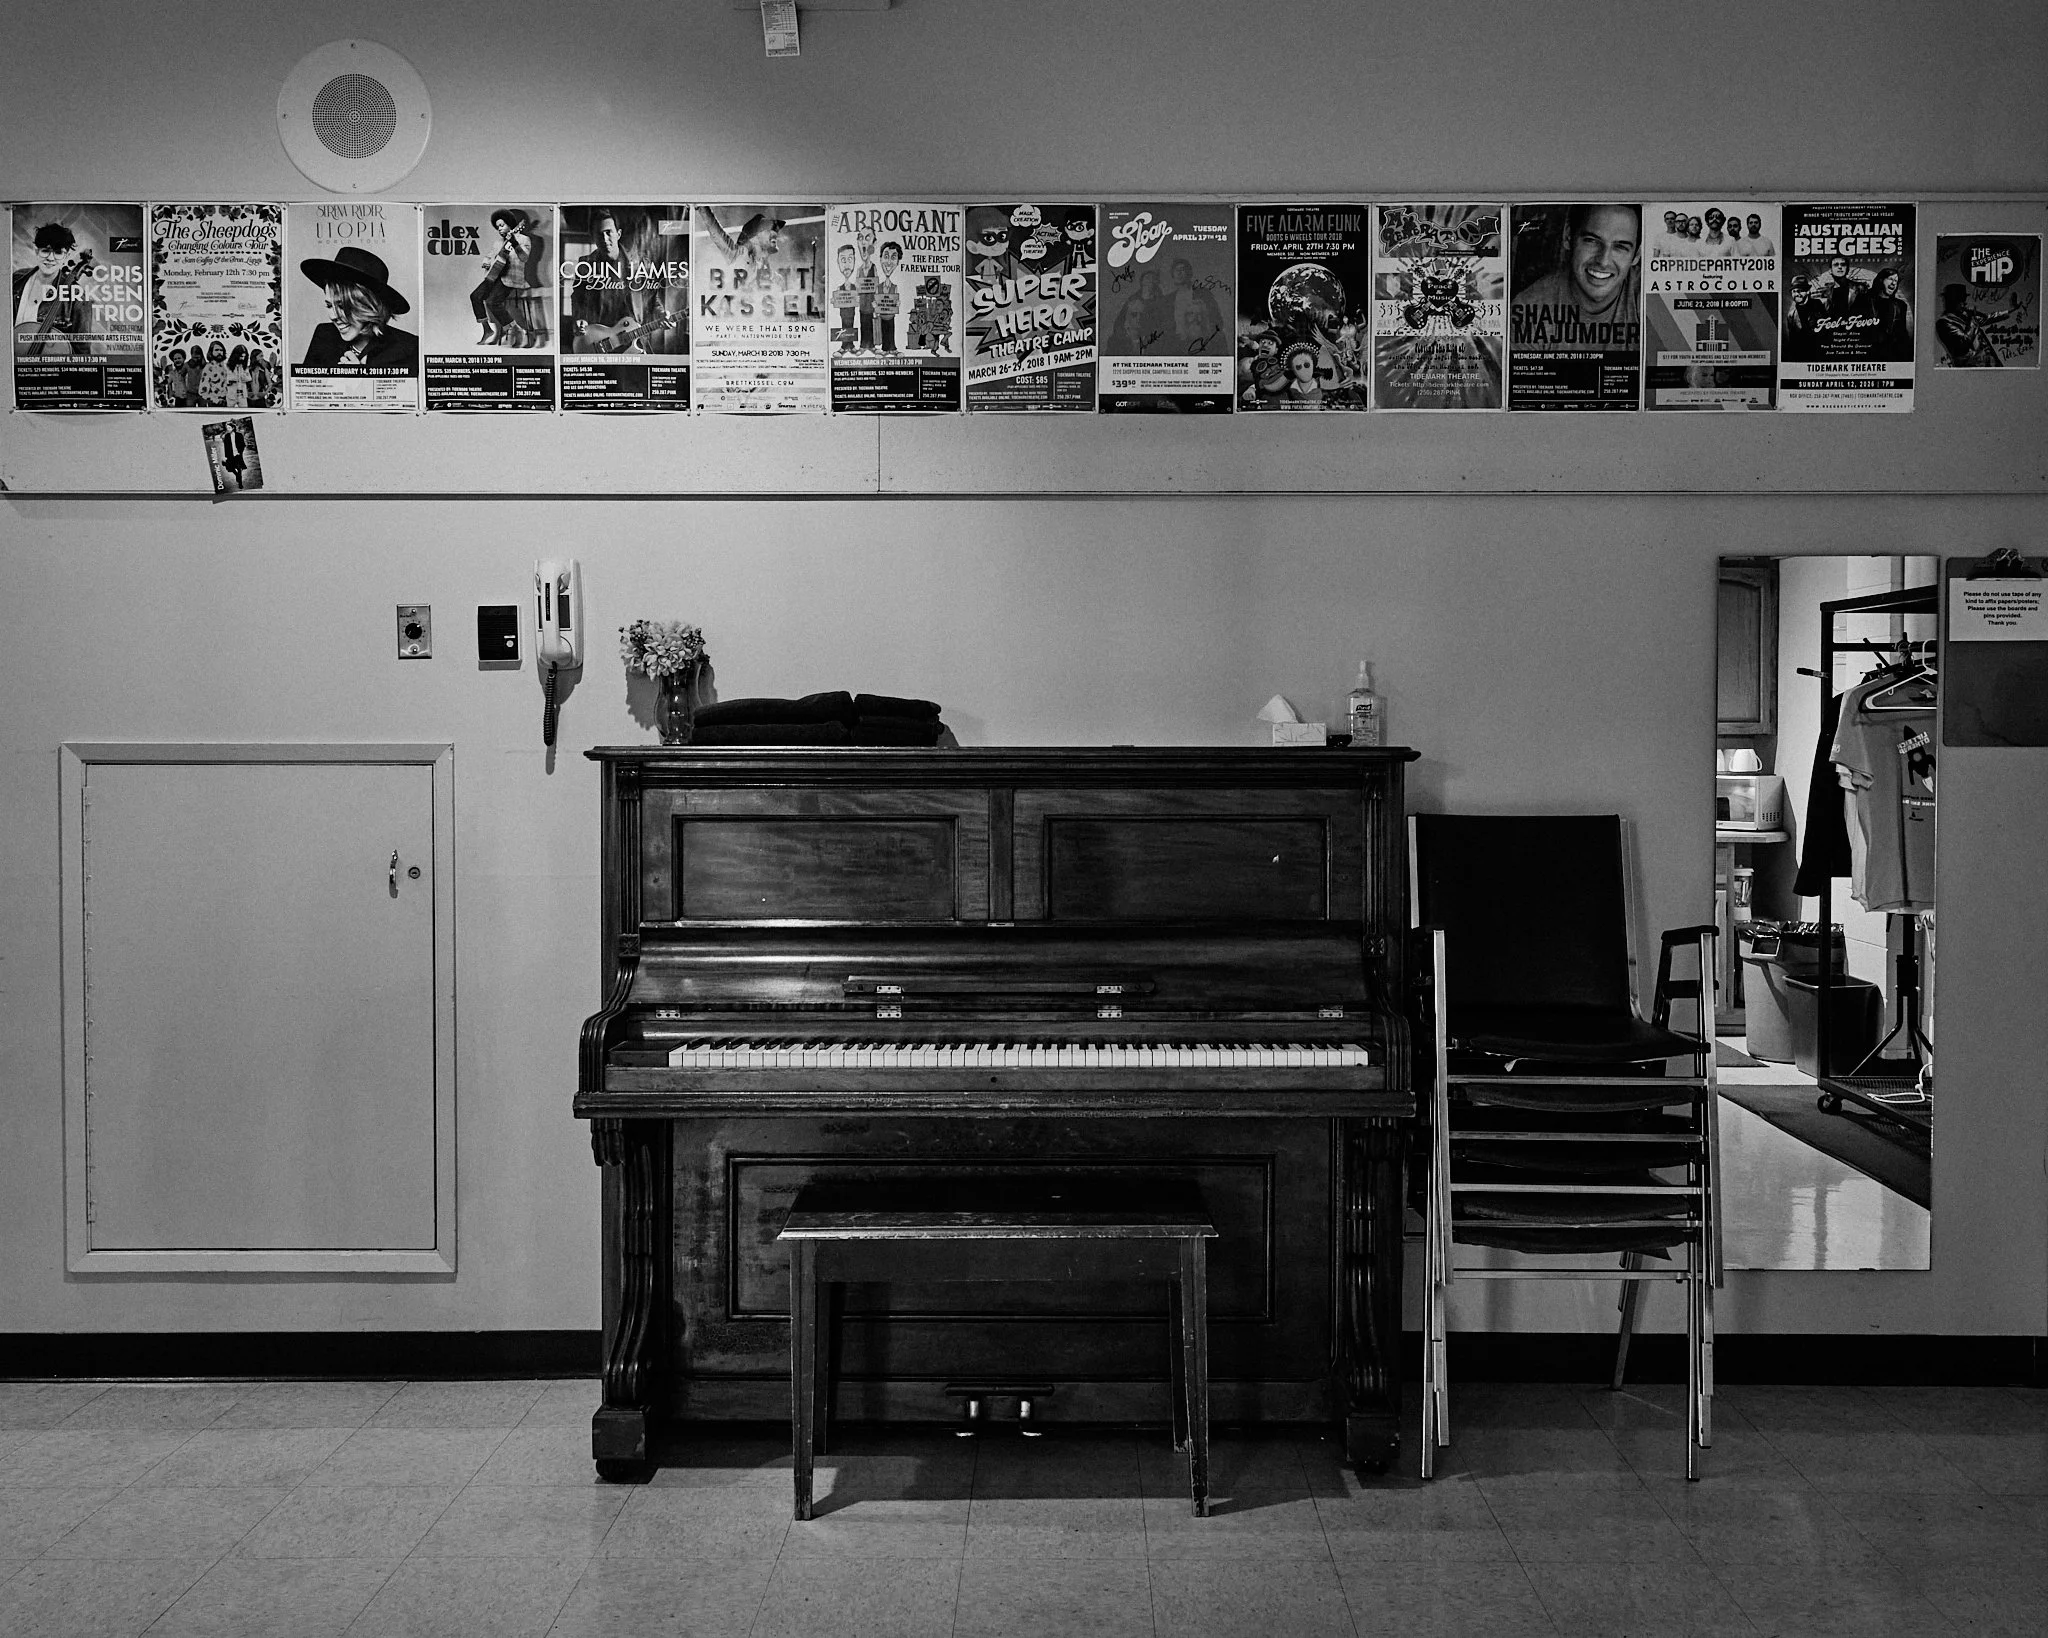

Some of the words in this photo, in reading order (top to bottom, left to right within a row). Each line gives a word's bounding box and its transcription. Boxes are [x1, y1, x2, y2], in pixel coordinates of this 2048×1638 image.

[154, 216, 190, 239] The
[192, 219, 277, 243] Sheepdogs
[427, 219, 480, 239] alex
[831, 214, 840, 227] THE
[837, 209, 960, 234] ARROGANT
[1246, 215, 1274, 239] FIVE
[1279, 214, 1324, 232] ALARM
[1328, 214, 1360, 232] FUNK
[1799, 223, 1903, 236] AUSTRALIAN
[316, 221, 386, 239] UTOPIA
[1289, 233, 1313, 241] WHEELS
[1314, 233, 1327, 241] TOUR
[168, 240, 209, 254] Changing
[211, 240, 243, 251] Colours
[244, 240, 269, 250] Tour
[427, 239, 481, 256] CUBA
[902, 235, 961, 252] WORMS
[1107, 212, 1173, 267] Sloan
[1251, 243, 1280, 251] FRIDAY,
[1283, 243, 1304, 251] APRIL
[1306, 243, 1324, 251] 27TH
[1326, 243, 1340, 251] 7:30
[1342, 243, 1355, 251] PM
[912, 254, 928, 263] THE
[928, 254, 949, 263] FIRST
[1971, 248, 1991, 260] THE
[1971, 249, 2011, 267] EXPERIENCE
[92, 264, 143, 283] CRIS
[163, 269, 193, 277] Monday,
[194, 269, 224, 277] February
[560, 261, 621, 279] COLIN
[626, 261, 689, 281] JAMES
[900, 264, 940, 273] FAREWELL
[941, 264, 961, 273] TOUR
[1650, 259, 1775, 272] CRPRIDEPARTY2018
[1971, 257, 2014, 282] HIP
[585, 275, 625, 290] Blues
[629, 276, 661, 292] Trio
[709, 268, 810, 290] BRETT
[1650, 280, 1775, 291] ASTROCOLOR
[42, 284, 143, 302] DERKSEN
[973, 272, 1087, 315] SUPER
[92, 304, 144, 322] TRIO
[700, 294, 820, 317] KISSEL
[1511, 303, 1580, 325] SHAUN
[995, 303, 1074, 338] HERO
[1814, 316, 1843, 333] Feel
[1845, 314, 1880, 331] Fever
[33, 334, 71, 342] INTERNATIONAL
[72, 334, 105, 342] PERFORMING
[105, 334, 119, 342] ARTS
[120, 334, 144, 342] FESTIVAL
[1514, 322, 1640, 344] MAJUMDER
[989, 334, 1050, 359] THEATRE
[1053, 327, 1093, 346] CAMP
[294, 367, 329, 376] WEDNESDAY,
[330, 367, 358, 376] FEBRUARY
[360, 367, 369, 376] 14,
[369, 367, 383, 376] 2018
[387, 367, 400, 376] 7:30
[400, 367, 409, 376] PM
[968, 366, 997, 380] MARCH
[999, 361, 1025, 374] 26-29,
[1027, 358, 1045, 369] 2018
[1054, 348, 1093, 364] 9AM-2PM
[1807, 364, 1848, 372] TIDEMARK
[1851, 364, 1887, 372] THEATRE
[1016, 376, 1035, 384] COST:
[1035, 376, 1049, 384] $85
[215, 464, 225, 490] Dominic
